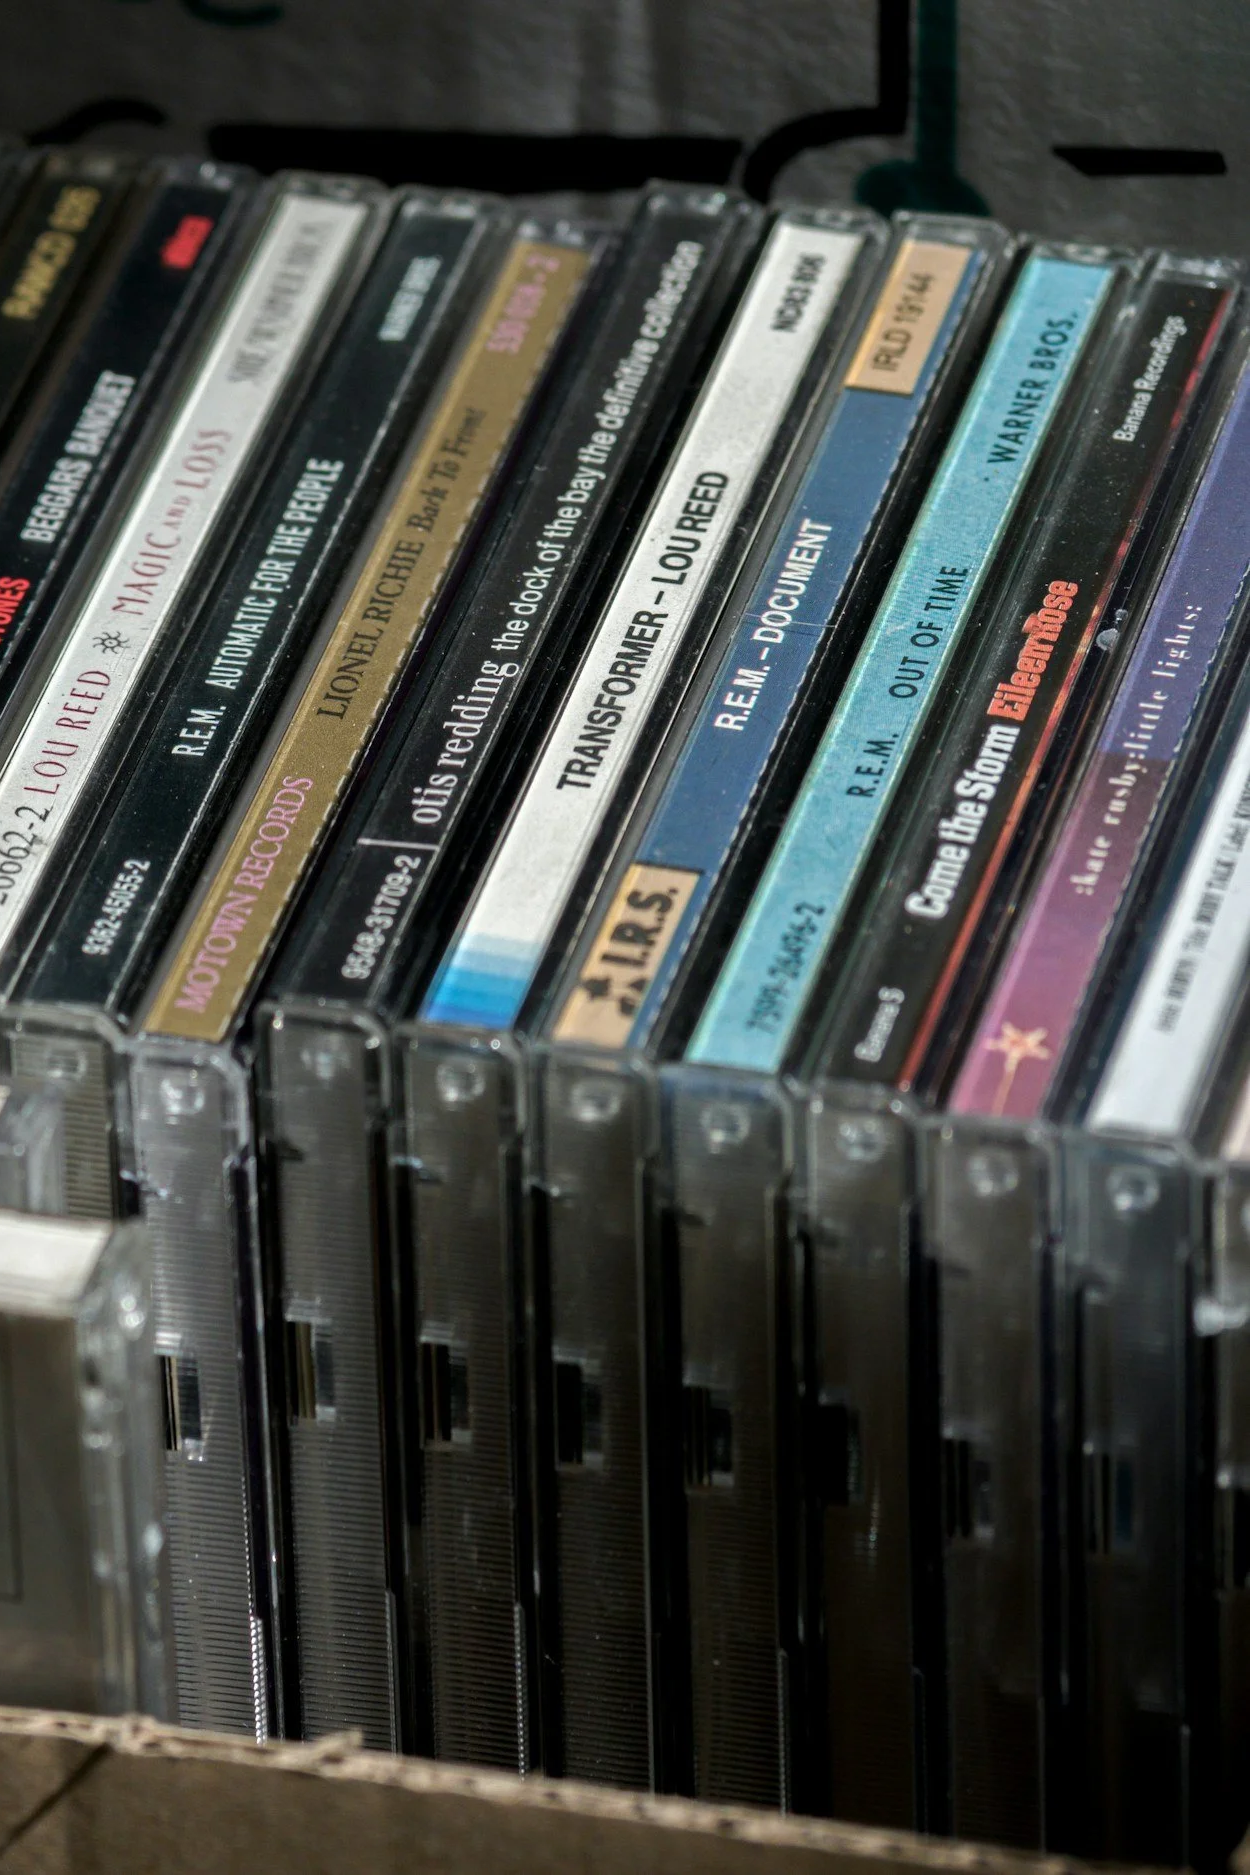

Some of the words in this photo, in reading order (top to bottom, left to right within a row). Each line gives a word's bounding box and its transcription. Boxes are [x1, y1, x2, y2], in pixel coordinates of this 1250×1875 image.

[639, 239, 705, 342] collection
[597, 337, 653, 434] definitive
[1134, 315, 1188, 396] Recordings
[580, 429, 616, 467] the
[1112, 390, 1152, 443] Banana
[19, 456, 91, 545] BEGGARS
[67, 369, 137, 459] BANQUET
[175, 428, 232, 491] LOSS
[282, 457, 344, 524] PEOPLE
[565, 460, 604, 504] bay
[166, 493, 194, 531] AND
[266, 523, 314, 557] THE
[550, 504, 583, 540] the
[111, 528, 182, 616] MAGIC
[249, 558, 296, 593] FOR
[536, 537, 564, 572] of
[846, 732, 900, 798] R.E.M.
[889, 656, 932, 700] OUT
[911, 615, 941, 648] OF
[926, 565, 969, 613] TIME
[987, 376, 1046, 464] WARNER
[1029, 312, 1078, 376] BROS.
[512, 571, 555, 620] dock
[205, 596, 277, 690] AUTOMATIC
[491, 617, 527, 653] the
[555, 608, 667, 791] TRANSFORMER
[651, 539, 700, 586] LOU
[676, 469, 730, 535] REED
[601, 888, 678, 967] I.R.S.
[713, 667, 770, 732] R.E.M.
[754, 517, 833, 645] DOCUMENT
[872, 325, 913, 372] IRLD
[58, 669, 112, 732] REED
[987, 640, 1044, 721] Eileen
[172, 705, 227, 757] R.E.M.
[175, 889, 255, 1015] MOTOWN
[235, 775, 313, 895] RECORDS
[316, 636, 377, 721] LIONEL
[363, 538, 425, 628] RICHIE
[406, 486, 448, 532] Back
[427, 459, 461, 481] To
[439, 660, 520, 770] redding
[23, 737, 78, 796] LOU
[954, 723, 1021, 800] Storm
[412, 770, 459, 826] otis
[936, 800, 984, 848] the
[82, 857, 151, 958] 9362-45055-2
[339, 854, 422, 981] 9548-31709-2
[905, 852, 960, 921] Come
